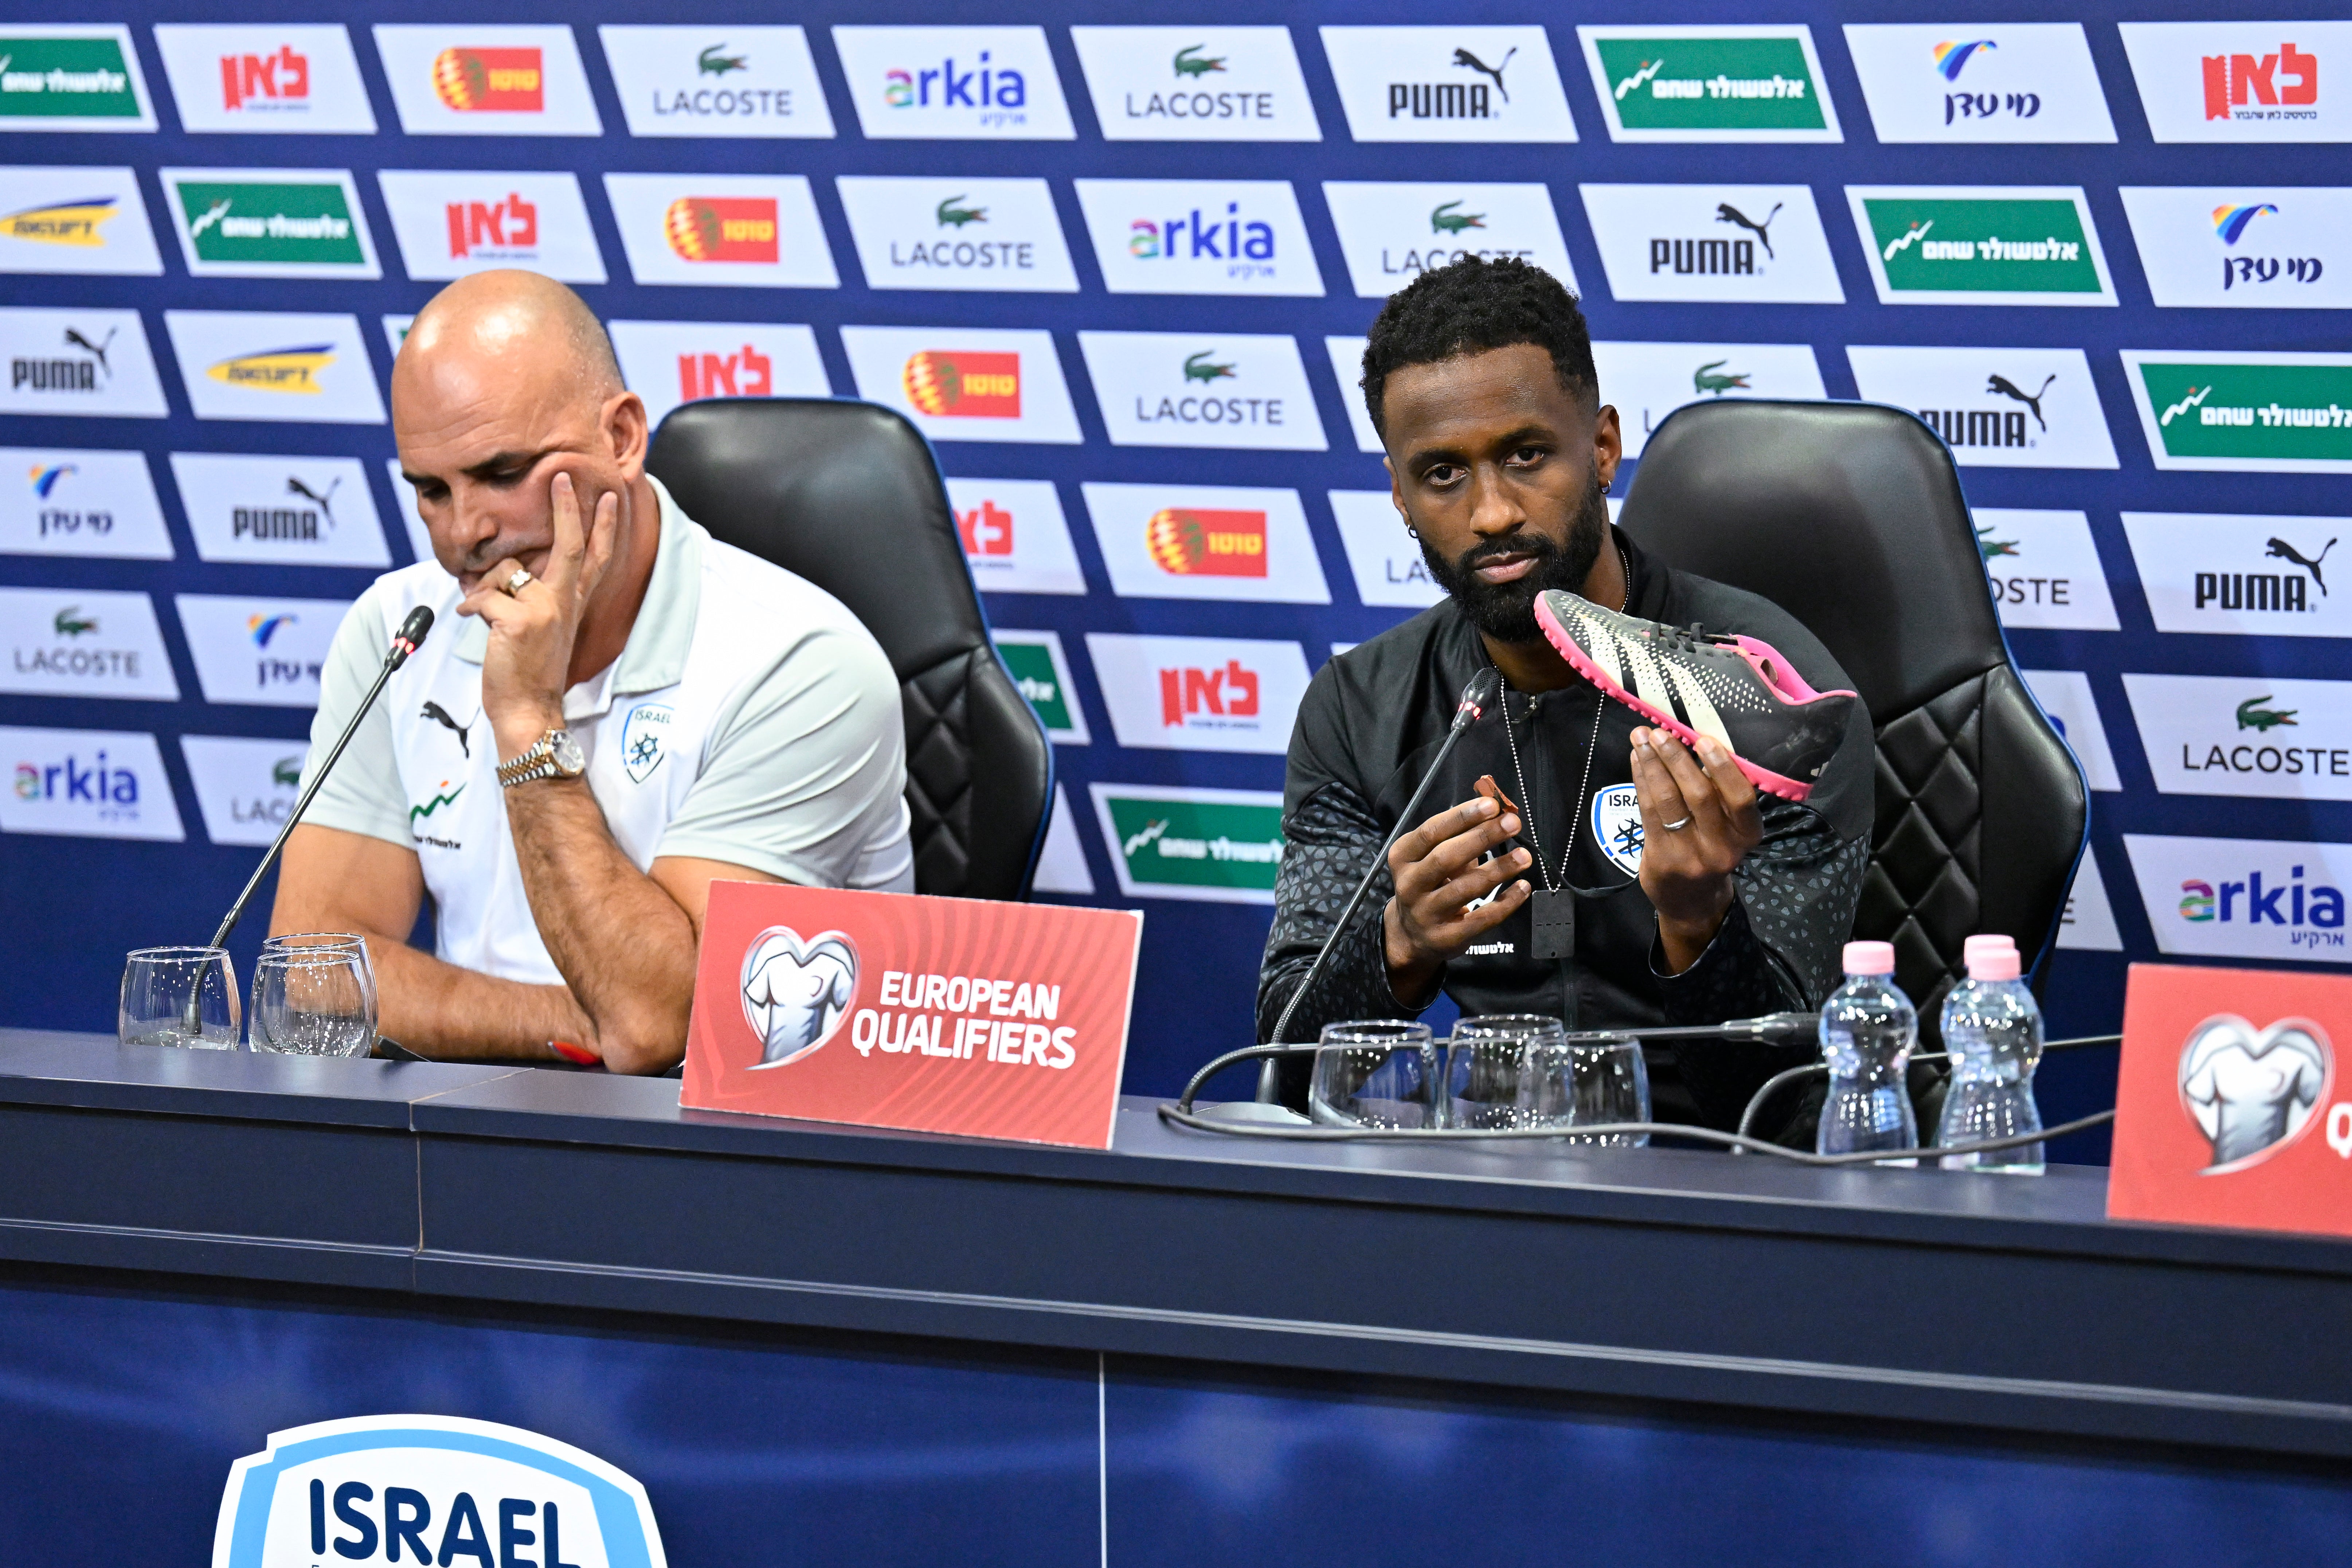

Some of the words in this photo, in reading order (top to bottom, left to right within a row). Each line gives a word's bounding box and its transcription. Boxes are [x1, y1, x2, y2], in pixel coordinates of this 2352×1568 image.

[489, 69, 539, 90] טוטו
[887, 51, 1025, 108] arkia
[1652, 79, 1703, 98] שחם
[1706, 75, 1804, 98] אלטשולר
[2202, 43, 2317, 120] לאן
[654, 90, 791, 116] LACOSTE
[1127, 92, 1273, 118] LACOSTE
[1390, 84, 1489, 118] PUMA
[1946, 93, 1999, 125] עדן
[2007, 93, 2040, 117] מי
[722, 219, 775, 242] טוטו
[1131, 203, 1274, 260] arkia
[891, 242, 1033, 269] LACOSTE
[1651, 239, 1753, 275] PUMA
[1922, 240, 1974, 260] שחם
[1977, 237, 2079, 260] אלטשולר
[2224, 257, 2280, 290] עדן
[2288, 258, 2322, 282] מי
[12, 359, 95, 391] PUMA
[963, 374, 1016, 397] טוטו
[1137, 397, 1282, 425] LACOSTE
[2201, 406, 2254, 426] שחם
[233, 507, 317, 541] PUMA
[1208, 532, 1262, 555] טוטו
[2195, 573, 2306, 611] PUMA
[14, 648, 139, 677] LACOSTE
[1160, 661, 1259, 727] לאן
[635, 709, 670, 724] ISRAEL
[2184, 744, 2349, 775] LACOSTE
[15, 751, 138, 802] arkia
[1609, 794, 1639, 806] ISRA
[2179, 865, 2344, 928] arkia
[2291, 932, 2344, 949] ארקיע
[880, 971, 1060, 1020] EUROPEAN
[851, 1009, 1077, 1069] QUALIFIERS
[310, 1479, 582, 1568] ISRAEL
